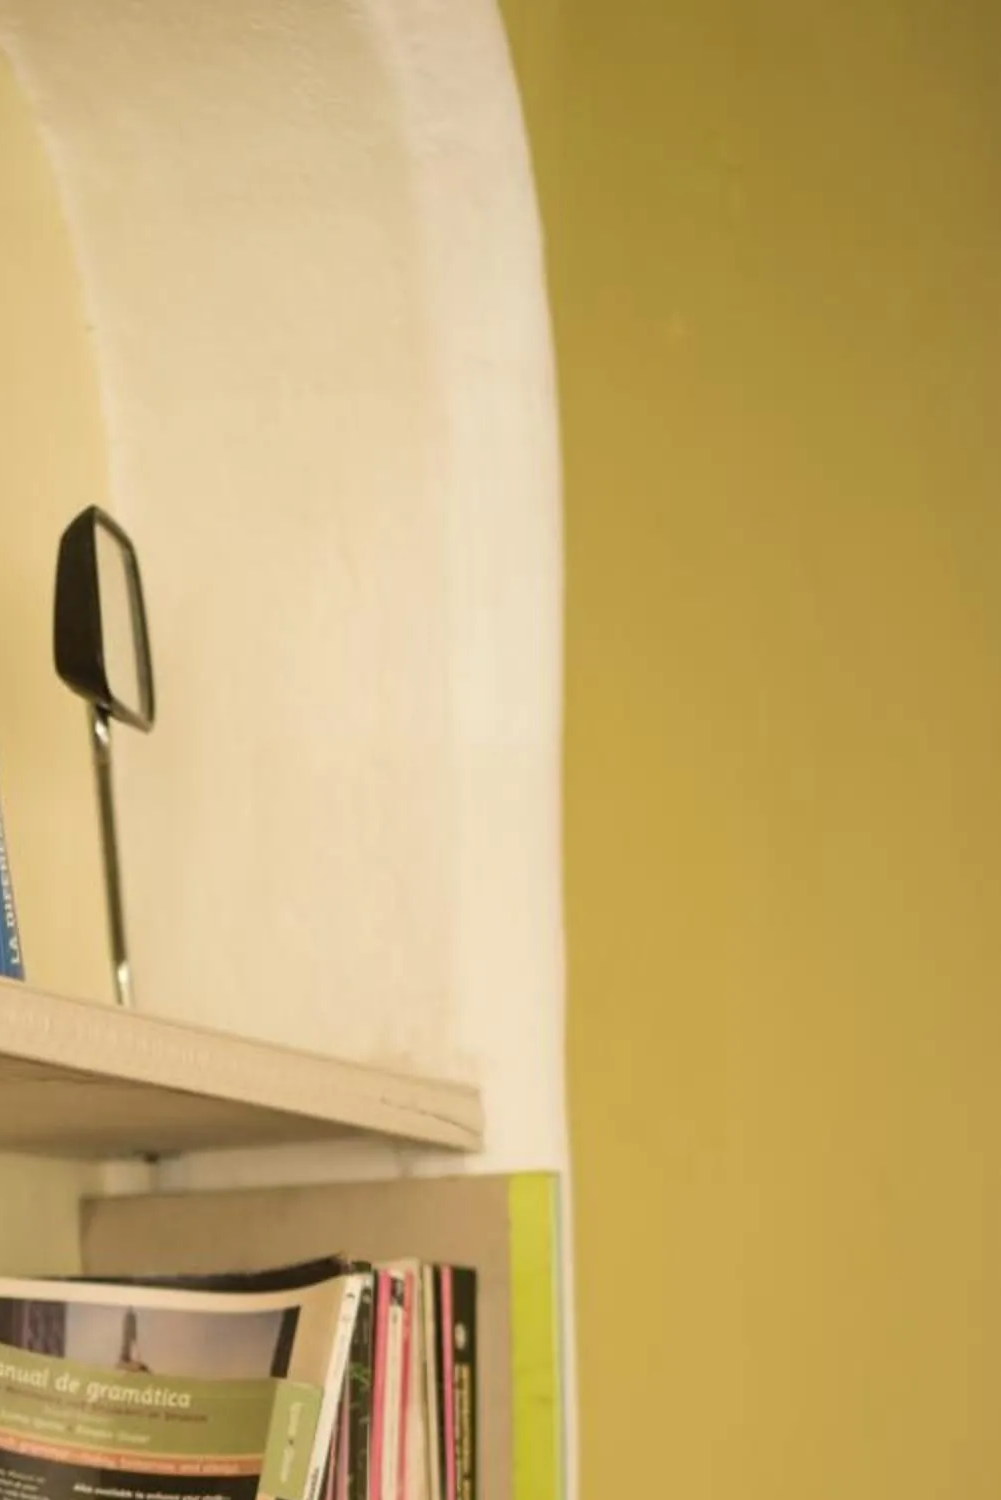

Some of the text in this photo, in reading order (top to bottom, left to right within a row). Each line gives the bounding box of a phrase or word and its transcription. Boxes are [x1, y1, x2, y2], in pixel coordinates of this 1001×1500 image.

[7, 935, 20, 964] LA
[54, 1372, 81, 1393] de
[86, 1378, 192, 1409] gramática
